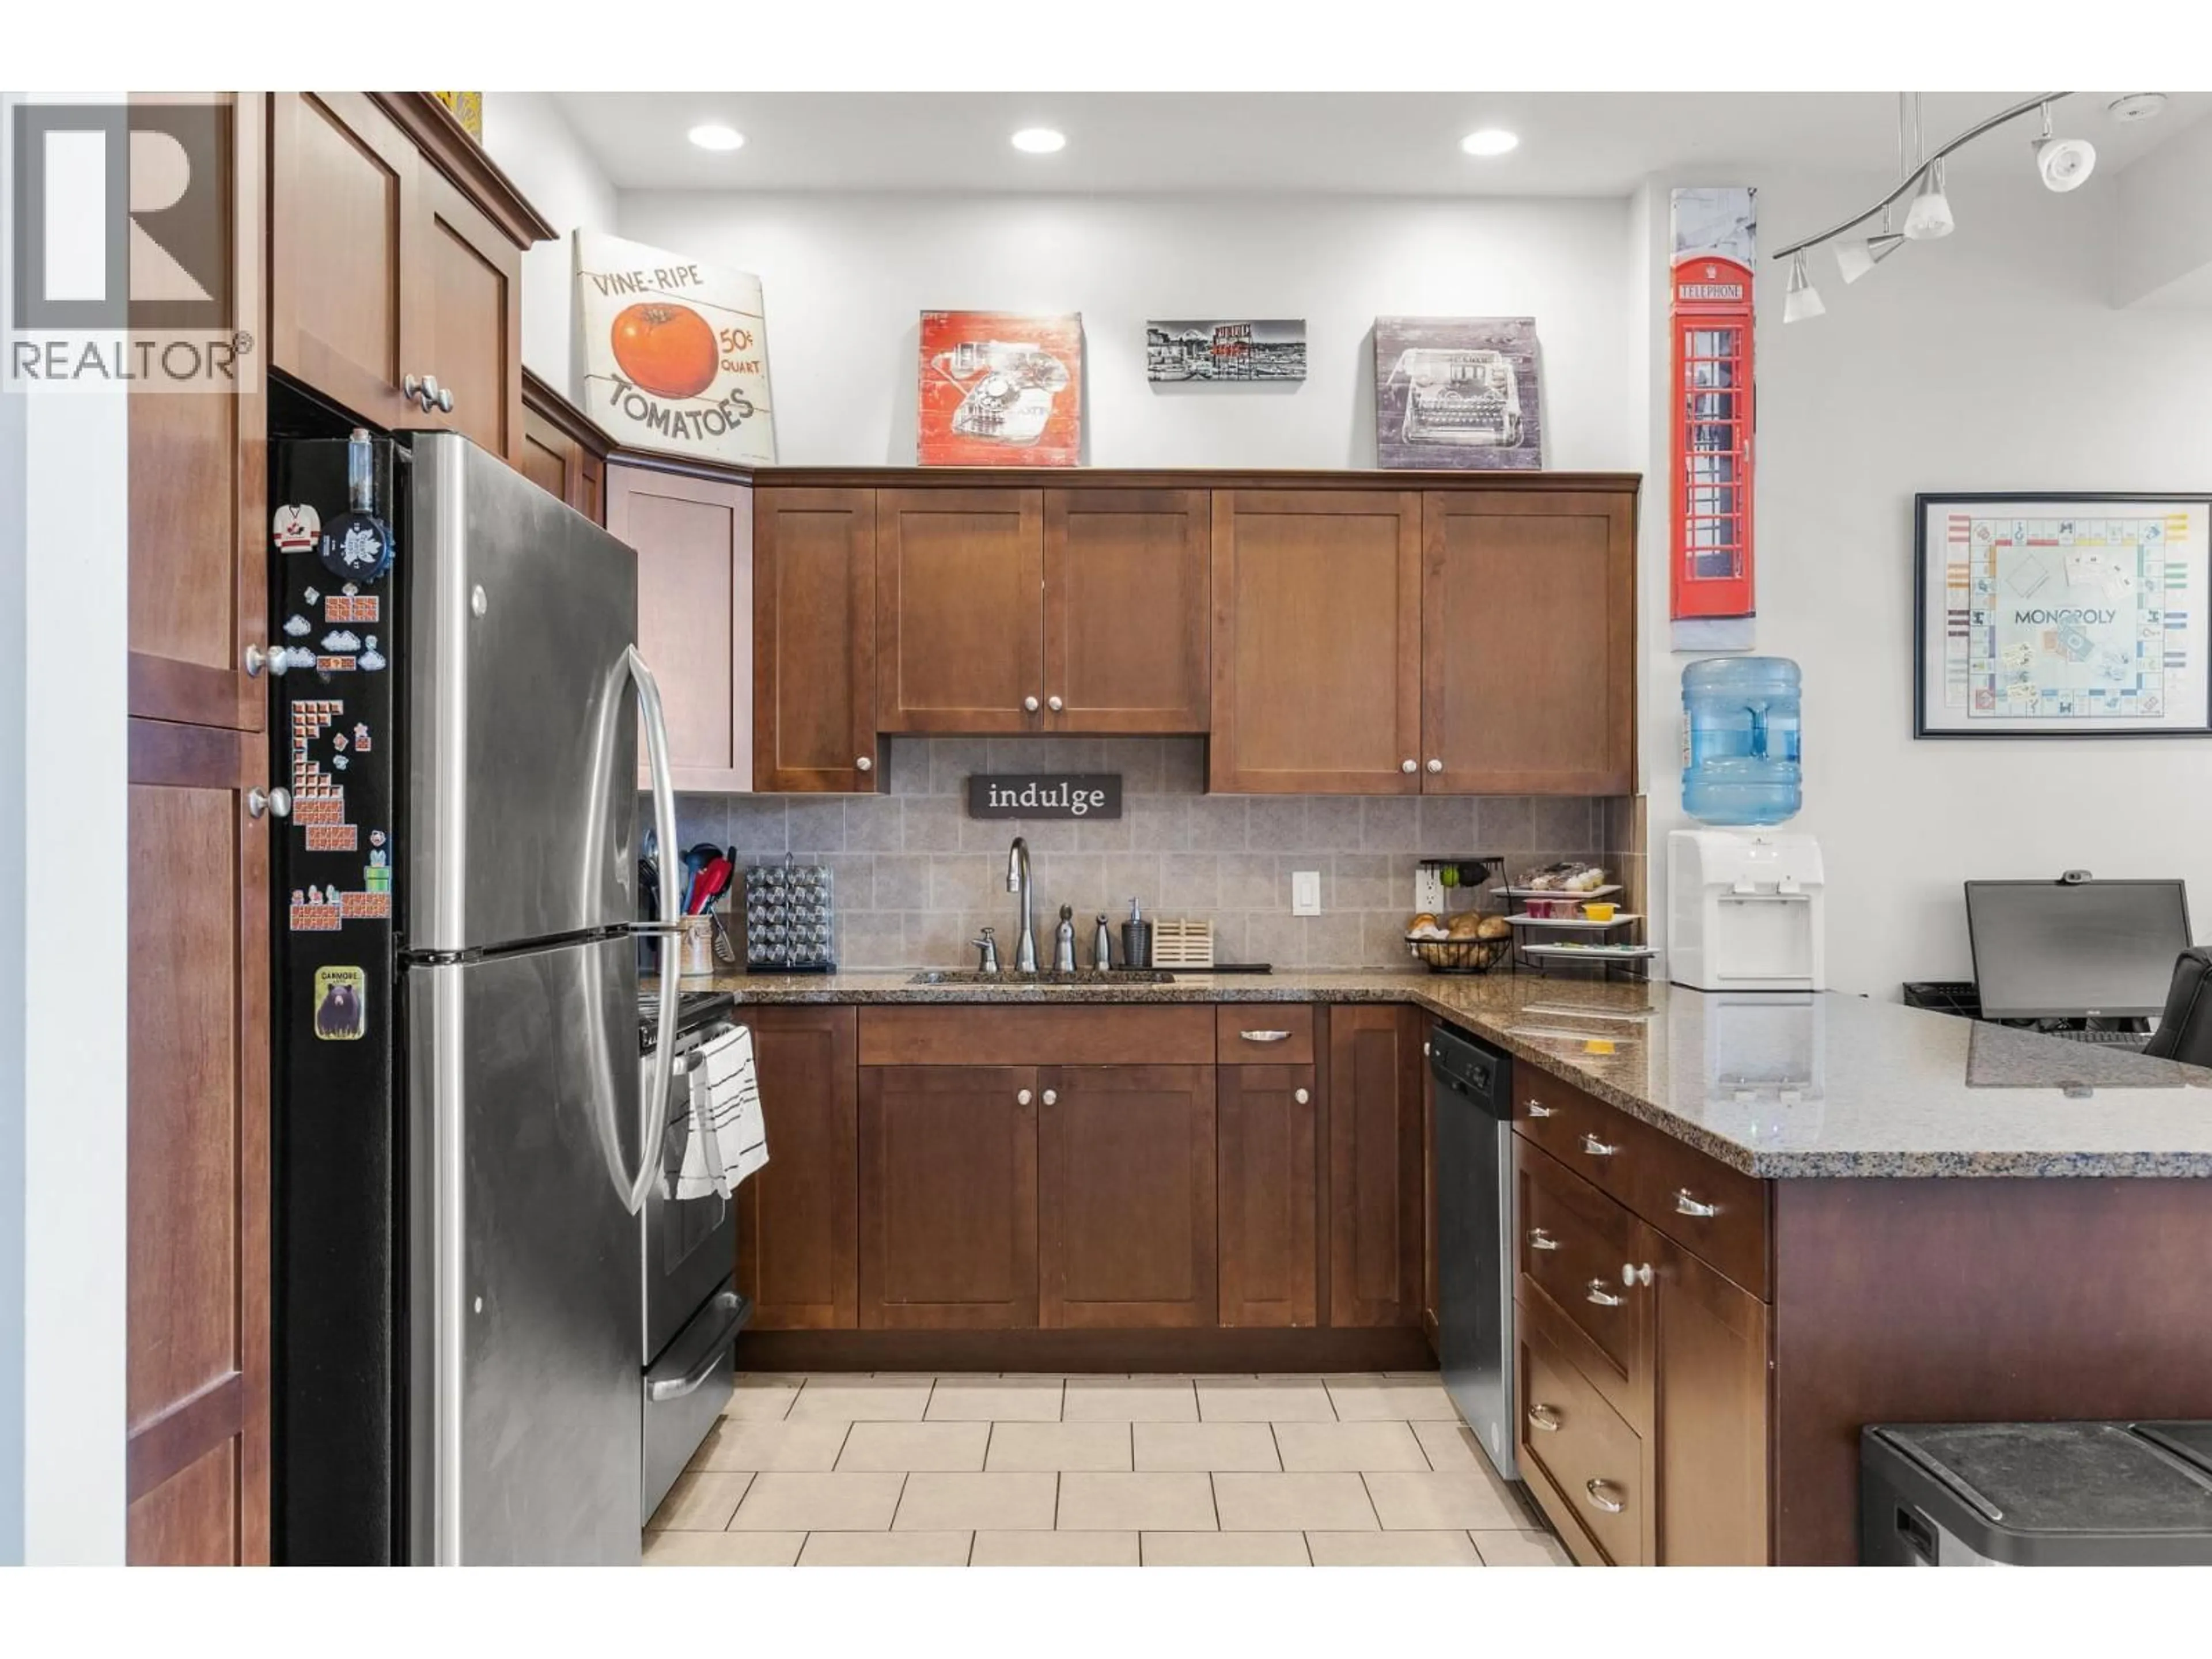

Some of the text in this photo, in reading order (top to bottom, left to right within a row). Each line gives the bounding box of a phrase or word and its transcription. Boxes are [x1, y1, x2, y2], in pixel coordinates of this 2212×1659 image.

[593, 265, 703, 296] VINE-RIPE
[721, 359, 762, 374] QUART
[609, 374, 753, 440] TOMATOES
[989, 782, 1105, 815] indulge
